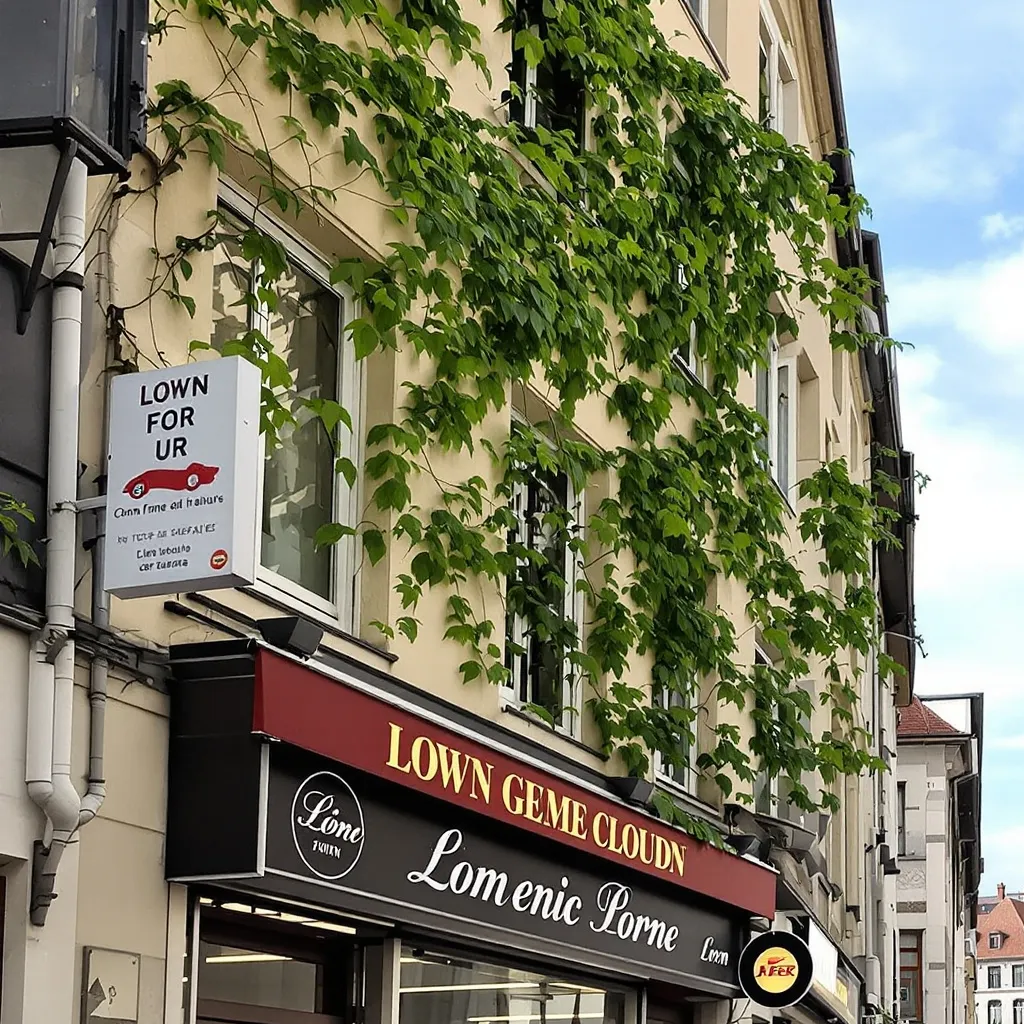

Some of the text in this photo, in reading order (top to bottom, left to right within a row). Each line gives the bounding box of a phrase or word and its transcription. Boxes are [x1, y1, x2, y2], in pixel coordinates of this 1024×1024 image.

[140, 374, 208, 406] LOWN
[147, 406, 194, 434] FOR
[156, 436, 187, 461] UR
[386, 722, 687, 877] LOWN GEME CLOUDN
